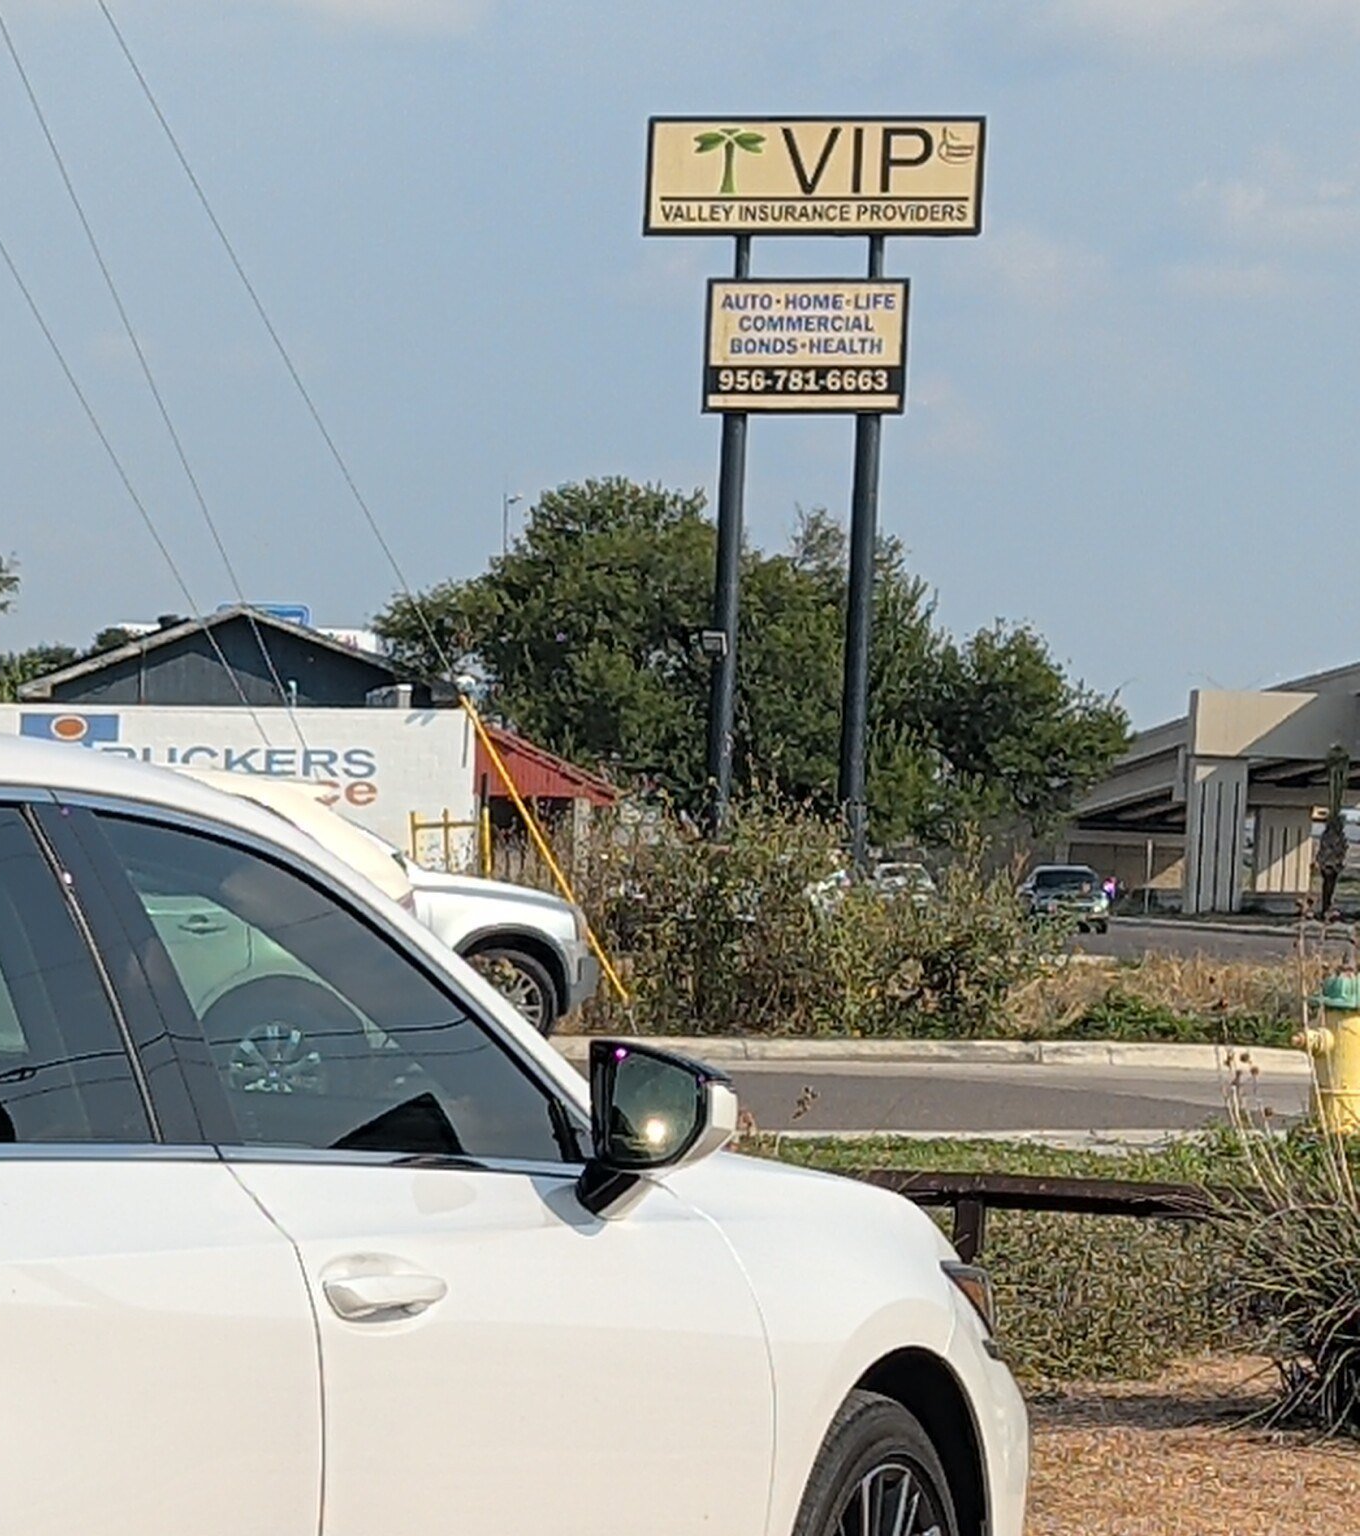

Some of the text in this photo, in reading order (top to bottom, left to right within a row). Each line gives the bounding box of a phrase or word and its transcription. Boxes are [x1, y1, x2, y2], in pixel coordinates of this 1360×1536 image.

[782, 127, 934, 195] VIP
[661, 204, 968, 223] VALLEY INSURANCE PROVIDERS
[739, 315, 874, 332] COMMERCIAL
[718, 370, 888, 392] 956-781-6663
